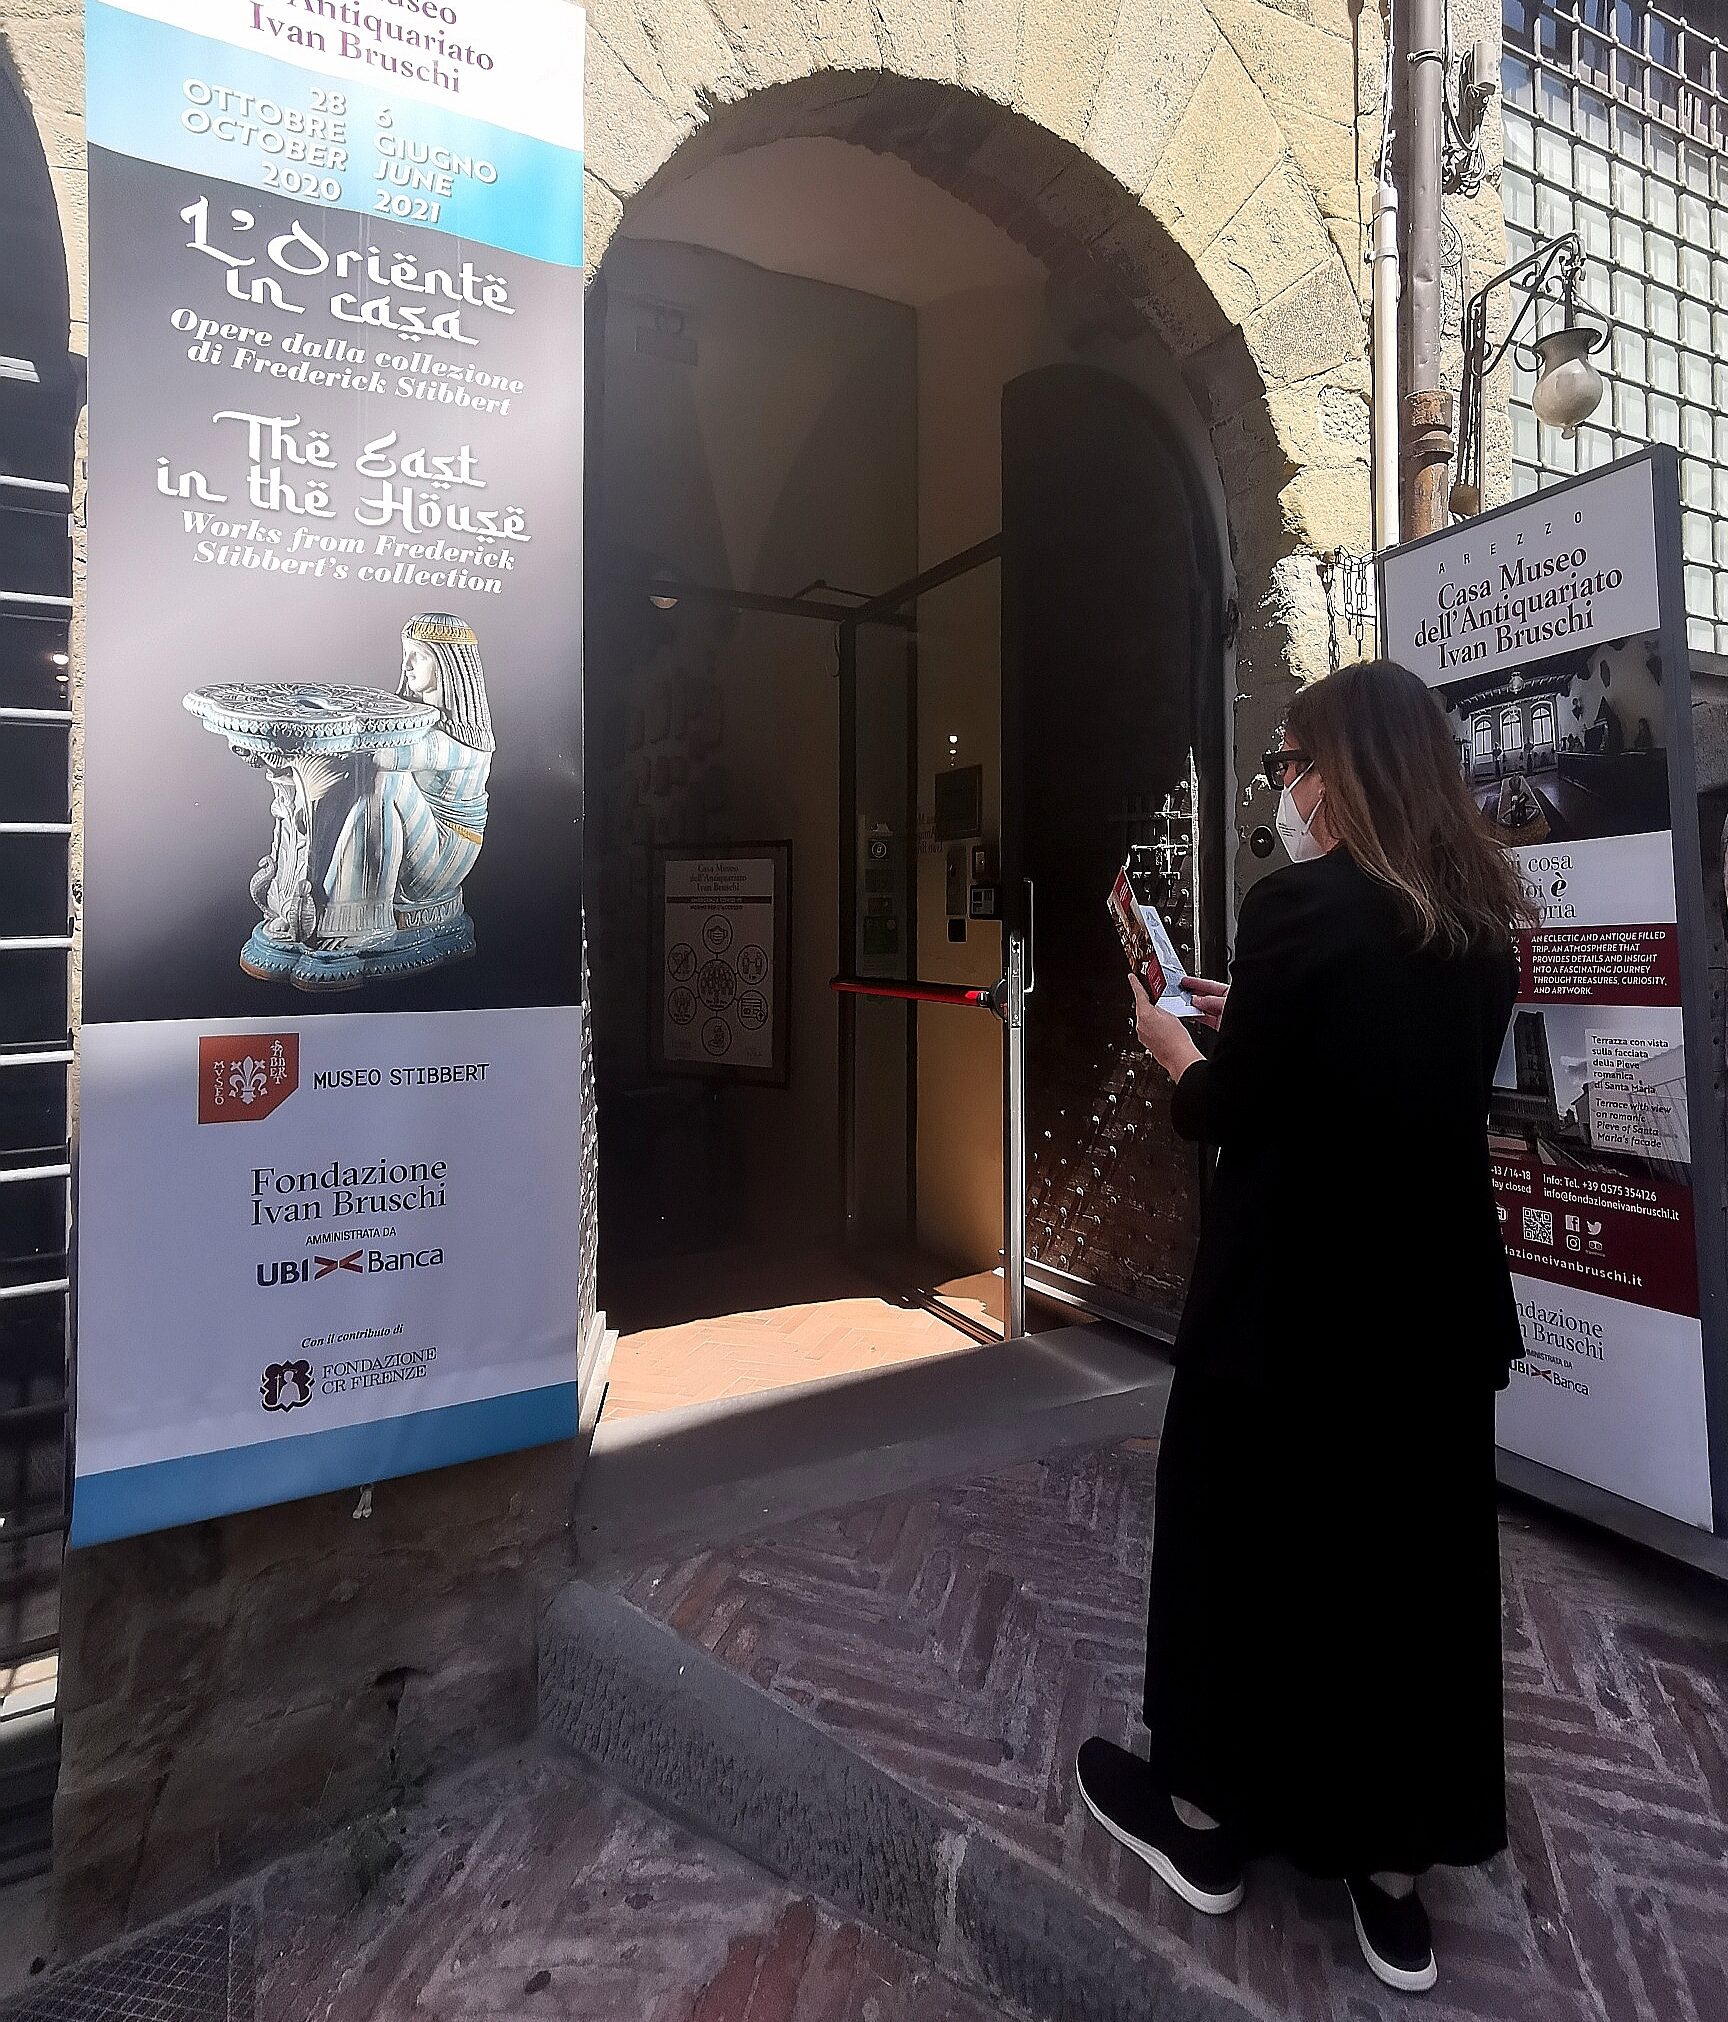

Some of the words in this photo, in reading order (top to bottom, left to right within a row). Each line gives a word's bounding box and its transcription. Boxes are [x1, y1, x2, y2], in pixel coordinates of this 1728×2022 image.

[249, 2, 326, 52] Ivan
[338, 30, 460, 93] Bruschi
[182, 78, 347, 144] OTTOBRE
[310, 87, 347, 116] 28
[375, 109, 394, 129] 6
[180, 108, 349, 172] OCTOBER
[374, 133, 498, 184] GIUGNO
[261, 160, 342, 202] 2020
[373, 160, 455, 197] JUNE
[374, 189, 441, 223] 2021
[225, 267, 306, 314] in
[170, 307, 272, 347] Opere
[281, 332, 366, 364] dalla
[374, 349, 525, 395] collezione
[187, 341, 222, 365] di
[230, 347, 386, 394] Frederick
[395, 375, 512, 417] Stibbert
[355, 429, 487, 489] East
[156, 456, 228, 504] in
[182, 509, 282, 545] Works
[286, 527, 367, 554] from
[374, 534, 516, 572] Frederick
[193, 541, 349, 583] Stibbert's
[357, 559, 503, 595] collection
[1437, 578, 1492, 611] Casa
[1499, 547, 1588, 592] Museo
[1413, 567, 1624, 649] dell'Antiquariato
[1437, 637, 1488, 671] Ivan
[1495, 600, 1595, 655] Bruschi
[1527, 855, 1574, 873] cosa
[1550, 871, 1568, 898] è
[1531, 935, 1543, 944] AN
[1544, 934, 1580, 943] ECLECTIC
[1580, 933, 1598, 942] AND
[1600, 932, 1637, 941] ANTIQUE
[1638, 931, 1666, 940] FILLED
[1551, 945, 1563, 953] AN
[1564, 944, 1617, 953] ATMOSPHERE
[1619, 943, 1640, 952] THAT
[1532, 955, 1570, 963] PROVIDES
[1572, 955, 1603, 963] DETAILS
[1605, 955, 1623, 963] AND
[1624, 954, 1657, 963] INSIGHT
[1533, 966, 1551, 974] INTO
[1553, 966, 1559, 974] A
[1560, 965, 1611, 974] FASCINATING
[1613, 965, 1651, 974] JOURNEY
[1534, 976, 1572, 984] THROUGH
[1573, 976, 1620, 985] TREASURES,
[1552, 987, 1593, 995] ARTWORK.
[1591, 1036, 1627, 1045] Terrazza
[1630, 1039, 1646, 1047] con
[1647, 1039, 1669, 1048] vista
[1592, 1048, 1612, 1056] sulla
[1615, 1048, 1649, 1058] facciata
[313, 1069, 382, 1089] MUSEO
[389, 1063, 490, 1086] STIBBERT
[1593, 1059, 1614, 1067] della
[1616, 1060, 1640, 1069] Pieve
[1593, 1071, 1634, 1080] romanica
[1594, 1081, 1603, 1089] di
[1605, 1082, 1629, 1091] Santa
[1631, 1084, 1656, 1093] Maria
[1596, 1098, 1628, 1109] Terrace
[1630, 1102, 1649, 1111] with
[1651, 1104, 1672, 1113] view
[1609, 1113, 1646, 1122] romanic
[1597, 1121, 1620, 1131] Pieve
[1621, 1124, 1632, 1134] of
[1633, 1126, 1659, 1136] Santa
[1597, 1132, 1628, 1143] Maria's
[1631, 1136, 1662, 1147] facade
[251, 1158, 448, 1197] Fondazione
[1505, 1181, 1532, 1194] closed
[1509, 1168, 1531, 1180] 14-18
[1543, 1173, 1563, 1186] Info:
[1564, 1176, 1580, 1188] Tel.
[1582, 1180, 1599, 1191] +39
[1600, 1183, 1623, 1196] 0575
[1624, 1186, 1657, 1201] 354126
[251, 1197, 322, 1226] Ivan
[332, 1182, 447, 1217] Bruschi
[305, 1229, 380, 1246] AMMINISTRATA
[382, 1226, 398, 1239] DA
[257, 1258, 310, 1287] UBI
[368, 1247, 445, 1274] Banca
[1516, 1300, 1604, 1338] ndazione
[301, 1335, 325, 1349] Con
[326, 1333, 336, 1346] il
[336, 1326, 392, 1344] contributo
[393, 1323, 405, 1336] di
[1533, 1321, 1605, 1361] Bruschi
[322, 1347, 438, 1379] FONDAZIONE
[321, 1379, 348, 1396] CR
[350, 1364, 428, 1391] FIRENZE
[1553, 1371, 1590, 1396] Banca
